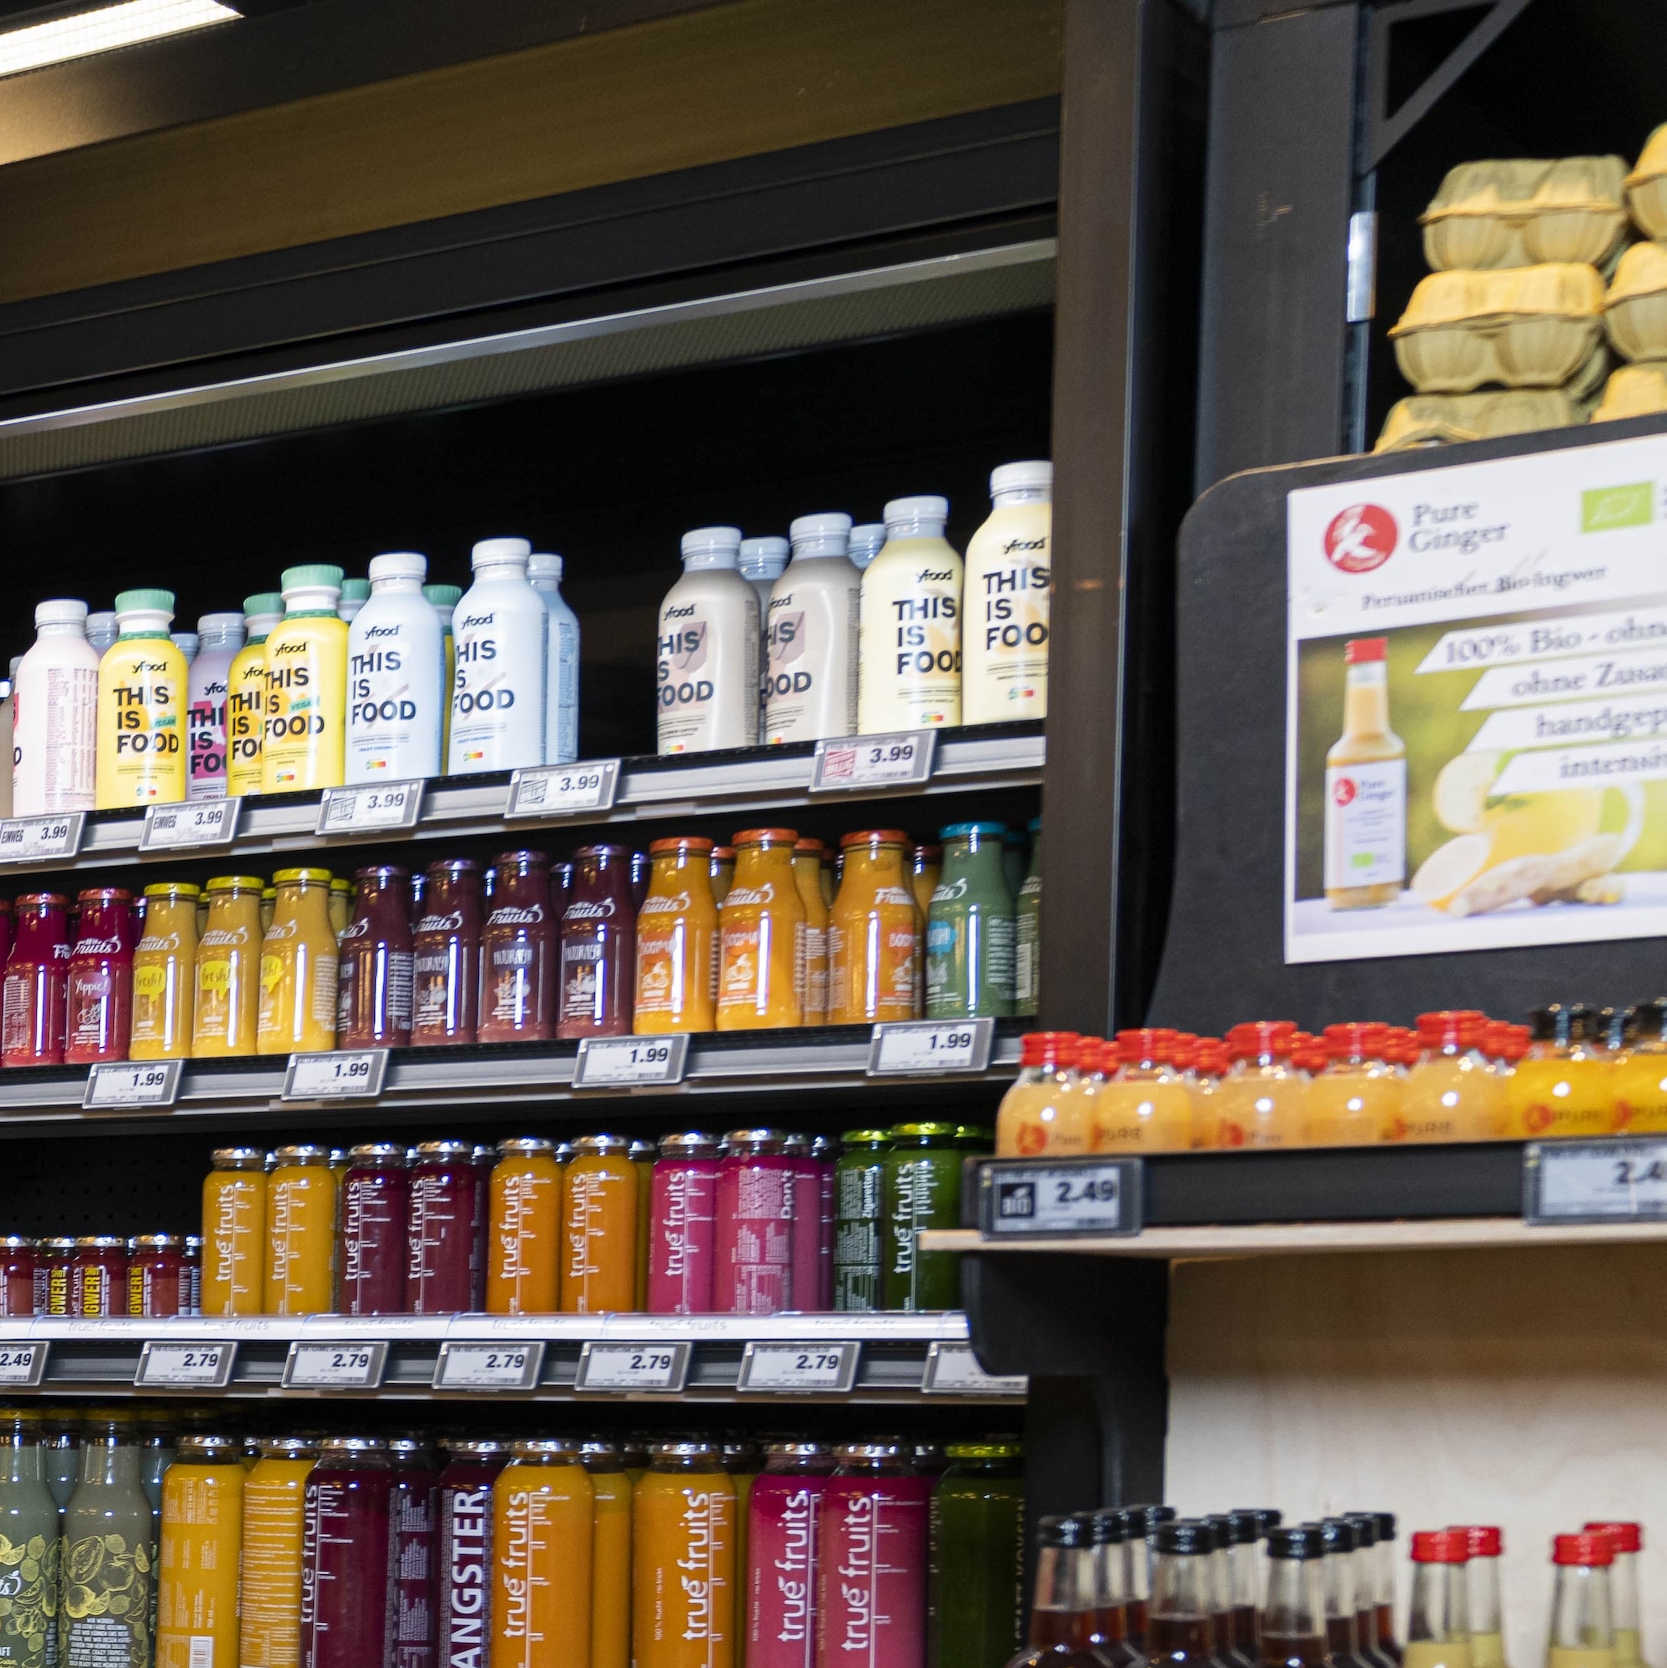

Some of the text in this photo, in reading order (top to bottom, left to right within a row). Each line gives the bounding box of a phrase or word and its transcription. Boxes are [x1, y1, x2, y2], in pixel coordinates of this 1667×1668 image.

[1413, 501, 1479, 527] Pure
[1003, 537, 1047, 555] yfood
[1408, 523, 1510, 555] Ginger
[916, 569, 954, 584] yfood
[983, 566, 1049, 594] THIS
[893, 597, 957, 621] THIS
[987, 599, 1012, 620] IS
[462, 611, 496, 629] yfood
[364, 624, 402, 640] yfood
[897, 625, 925, 647] IS
[275, 642, 309, 656] yfood
[1446, 633, 1520, 665] 100%
[1530, 628, 1581, 654] Bio
[132, 661, 168, 674] yfood
[351, 651, 402, 676] THIS
[265, 666, 310, 692] THIS
[353, 678, 371, 700] IS
[1512, 662, 1667, 697] ohne Zusa
[113, 686, 170, 707] THIS
[116, 710, 141, 730] IS
[352, 700, 417, 725] FOOD
[263, 714, 326, 741] FOOD
[116, 733, 180, 755] FOOD
[870, 744, 914, 764] 3.99
[559, 774, 600, 793] 3.99
[366, 792, 405, 810] 3.99
[194, 810, 223, 826] 3.99
[40, 825, 68, 841] 3.99
[929, 1032, 972, 1051] 1.99
[629, 1047, 668, 1065] 1.99
[132, 1071, 165, 1088] 1.99
[334, 1061, 370, 1079] 1.99
[1057, 1179, 1115, 1204] 2.49
[214, 1183, 234, 1283] true fruits
[499, 1175, 520, 1280] true fruits
[662, 1170, 686, 1276] true fruits
[183, 1352, 219, 1369] 2.79
[486, 1354, 525, 1370] 2.79
[795, 1354, 839, 1370] 2.79
[500, 1491, 529, 1639] true fruits
[677, 1491, 709, 1641] true fruits
[838, 1496, 872, 1651] true fruits
